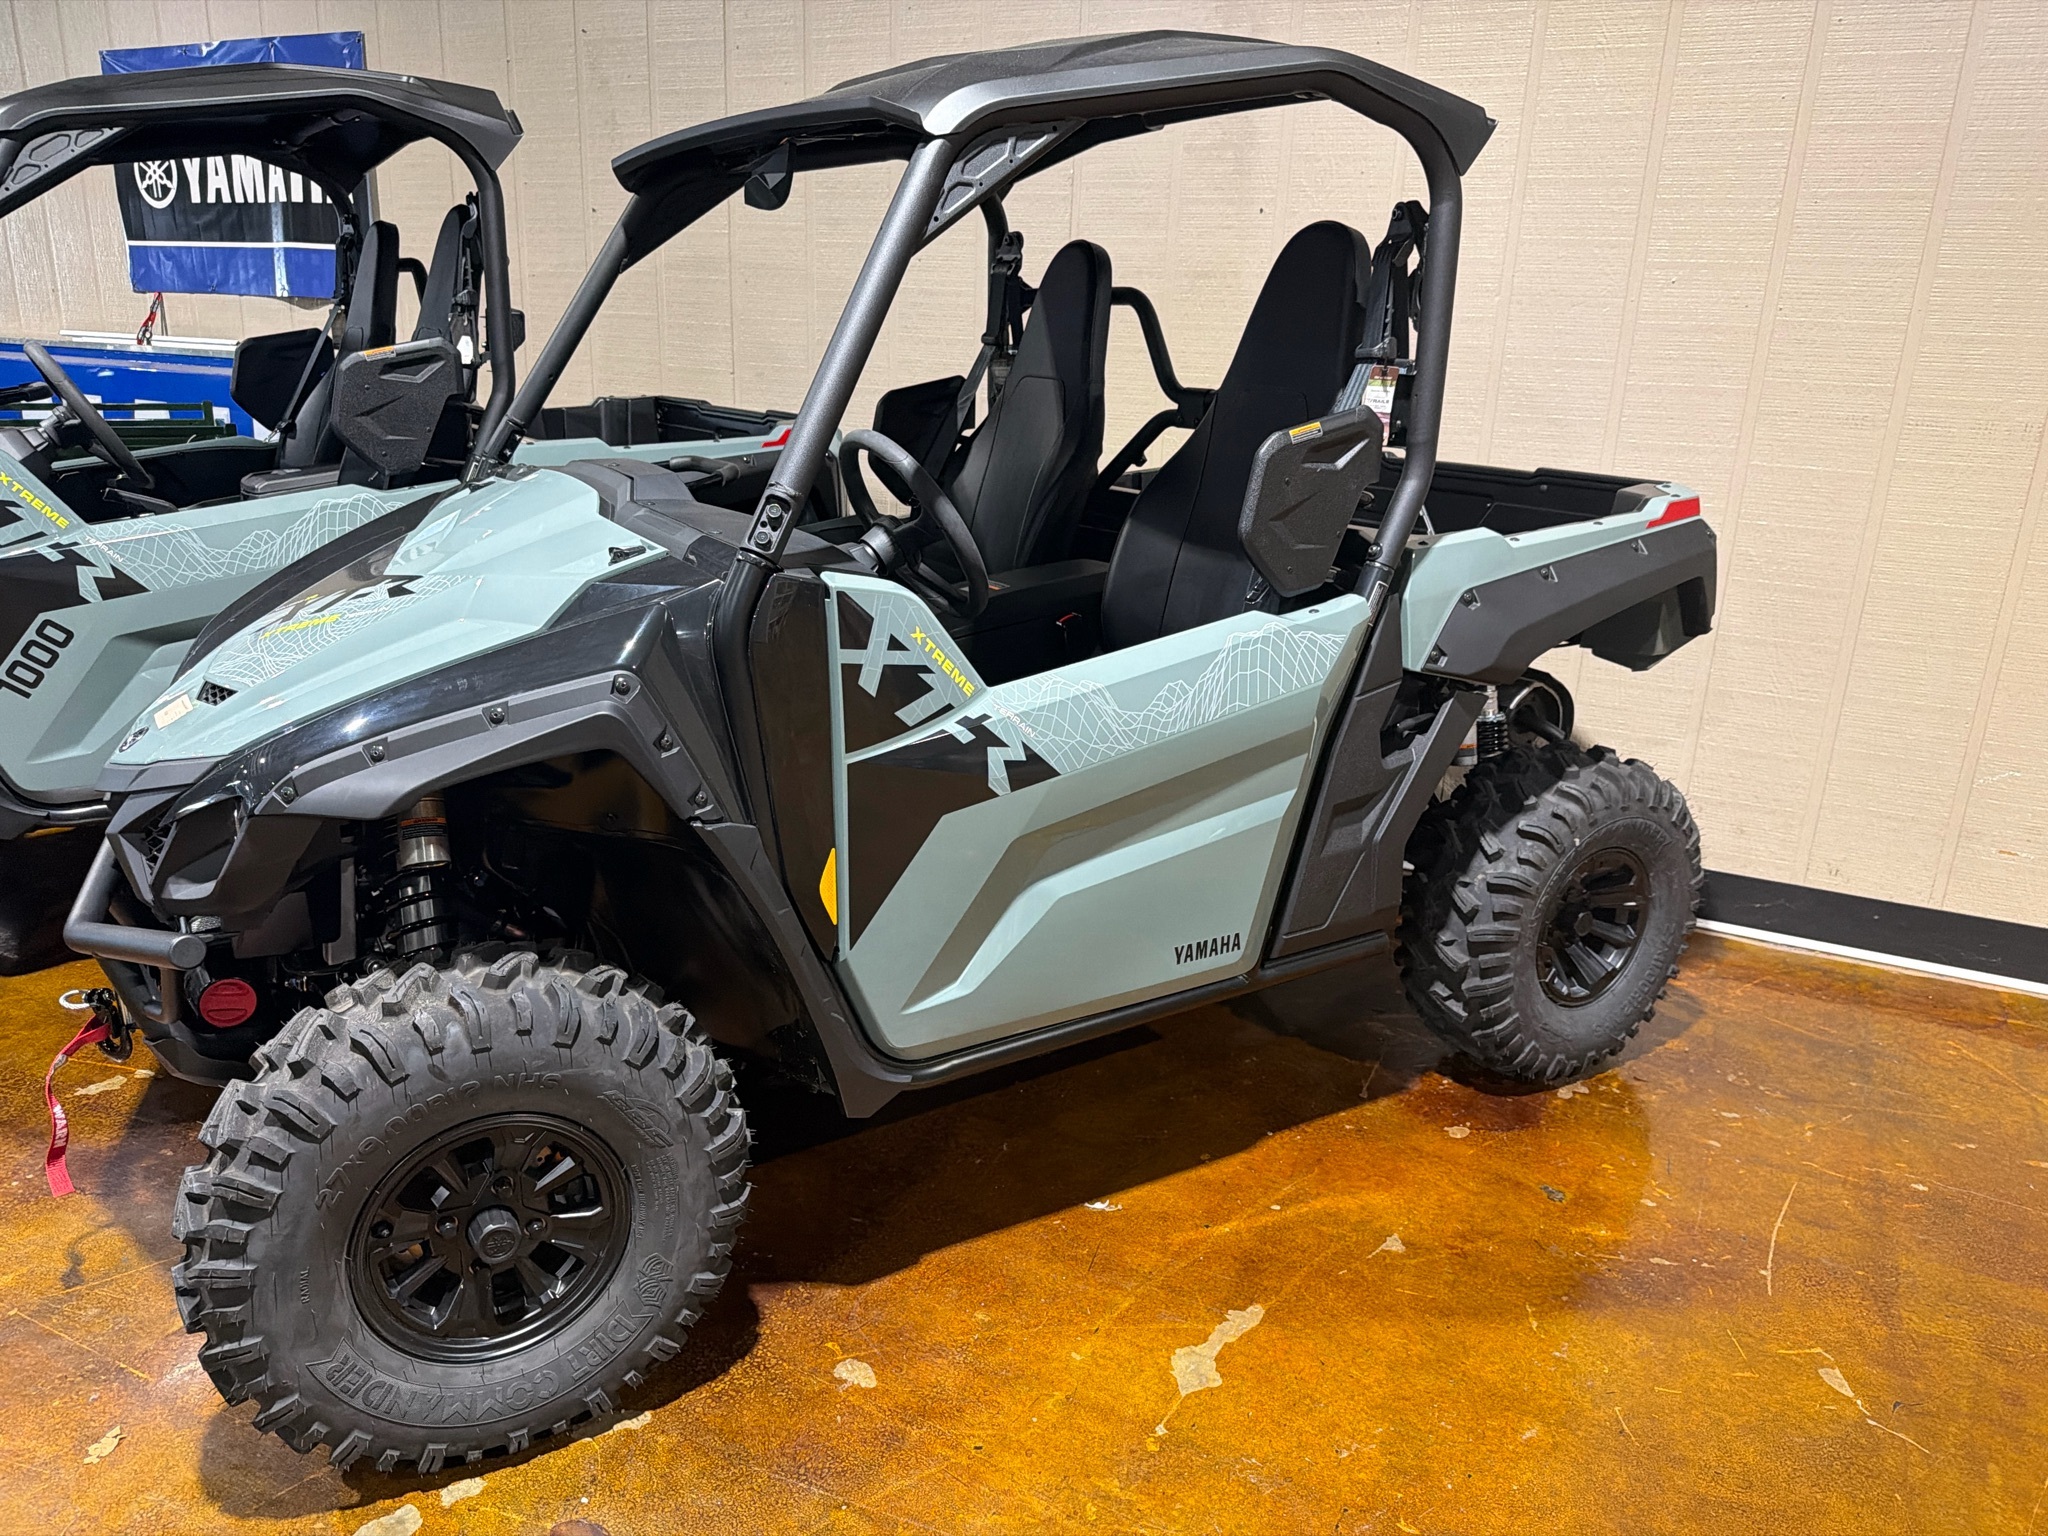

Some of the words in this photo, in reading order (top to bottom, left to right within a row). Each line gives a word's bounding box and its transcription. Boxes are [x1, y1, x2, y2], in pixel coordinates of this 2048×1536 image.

[0, 472, 70, 529] XTREME
[84, 536, 124, 563] TERRAIN
[0, 619, 75, 699] 1000
[910, 626, 976, 697] XTREME
[991, 703, 1036, 738] TERRAIN
[1174, 932, 1241, 965] YAMAHA
[53, 1104, 68, 1149] WARN
[570, 1313, 638, 1383] DIRT
[325, 1353, 560, 1423] COMMANDER
